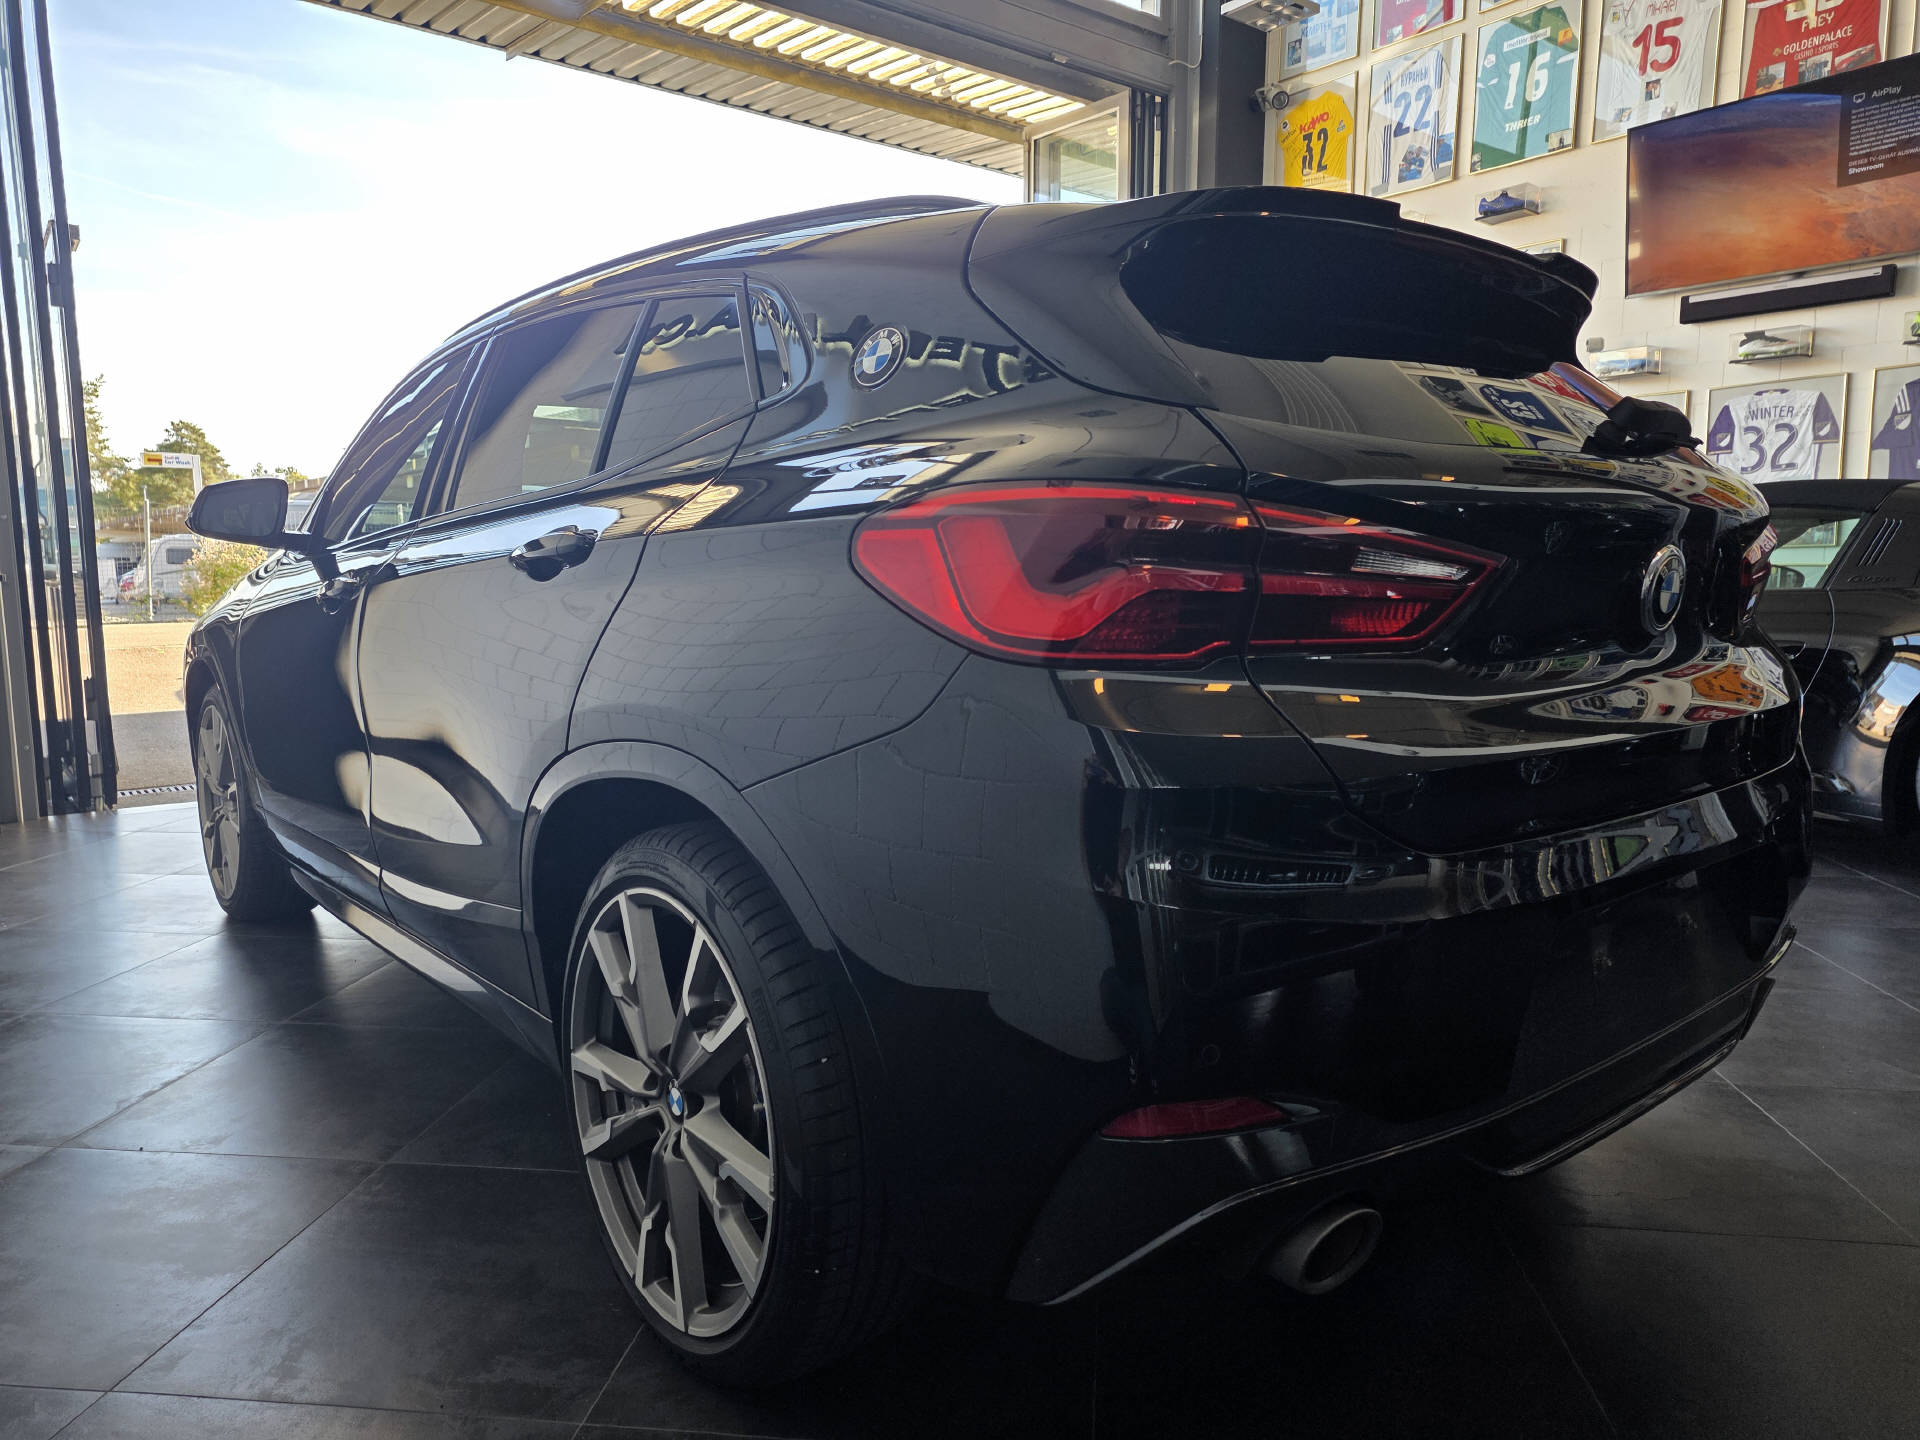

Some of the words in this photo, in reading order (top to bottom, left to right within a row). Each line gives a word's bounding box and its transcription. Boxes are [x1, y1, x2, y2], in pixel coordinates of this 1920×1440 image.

[1783, 24, 1853, 56] GOLDENPALACE
[1802, 11, 1835, 33] FEY
[1632, 16, 1683, 76] 15
[1504, 51, 1551, 110] 16
[1872, 86, 1902, 98] AirPlay
[1393, 84, 1433, 138] 22
[1301, 127, 1329, 177] 32
[1848, 162, 1885, 175] Showroom
[1748, 405, 1795, 421] WINTER
[1740, 422, 1799, 475] 32
